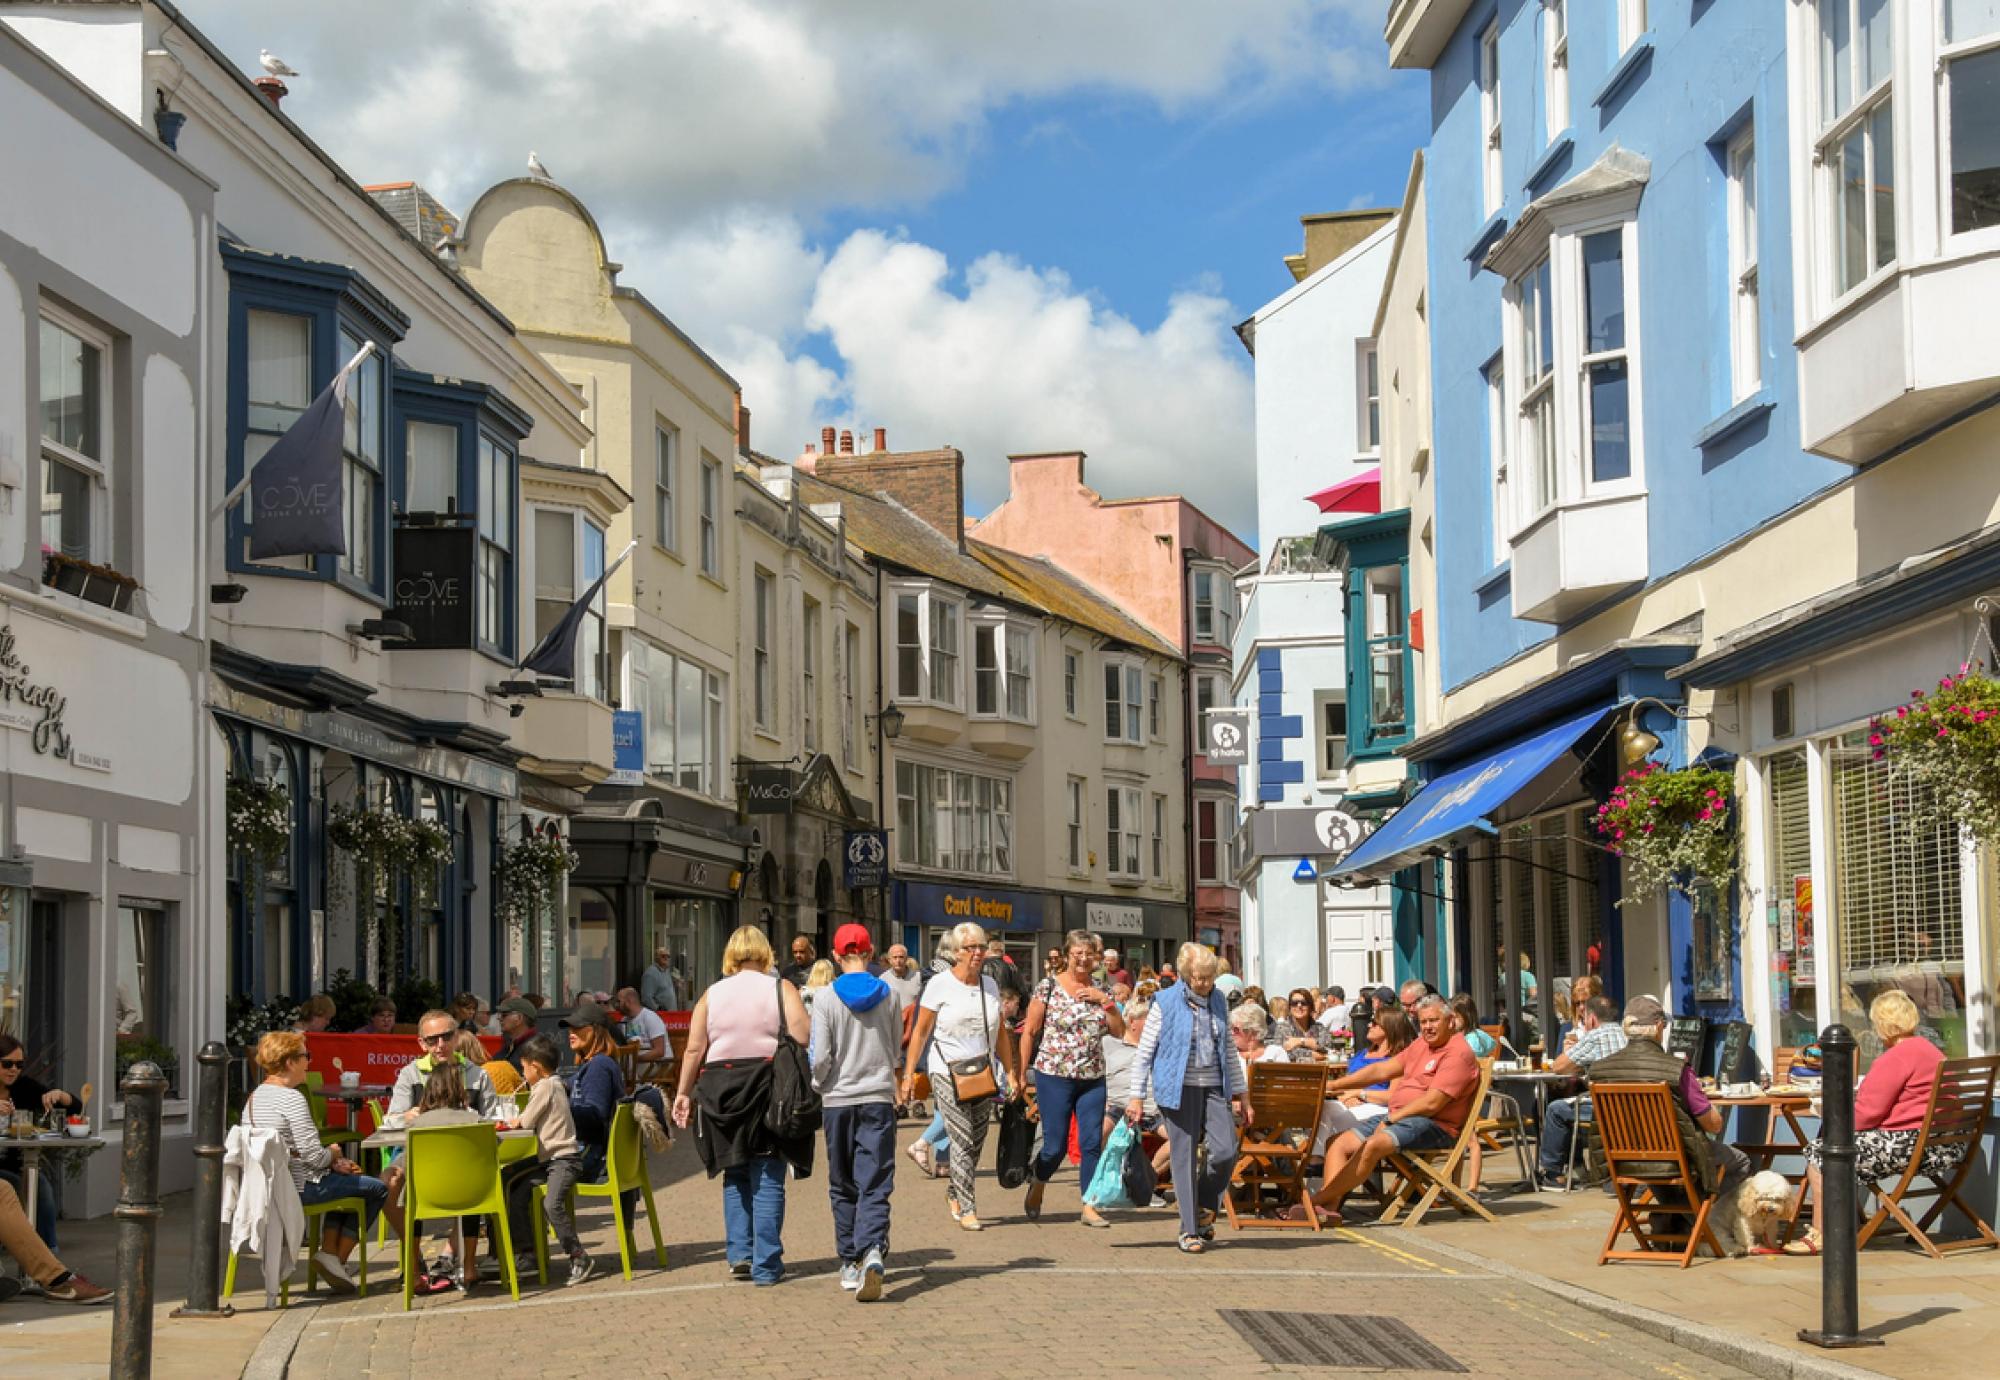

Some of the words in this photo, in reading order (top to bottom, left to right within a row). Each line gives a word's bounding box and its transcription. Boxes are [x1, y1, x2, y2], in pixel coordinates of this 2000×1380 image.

[261, 484, 328, 510] COVE
[396, 578, 459, 598] COVE
[944, 894, 971, 917] Card
[974, 895, 1013, 924] Factory
[1089, 910, 1112, 926] NEW
[1117, 912, 1143, 928] LOOK
